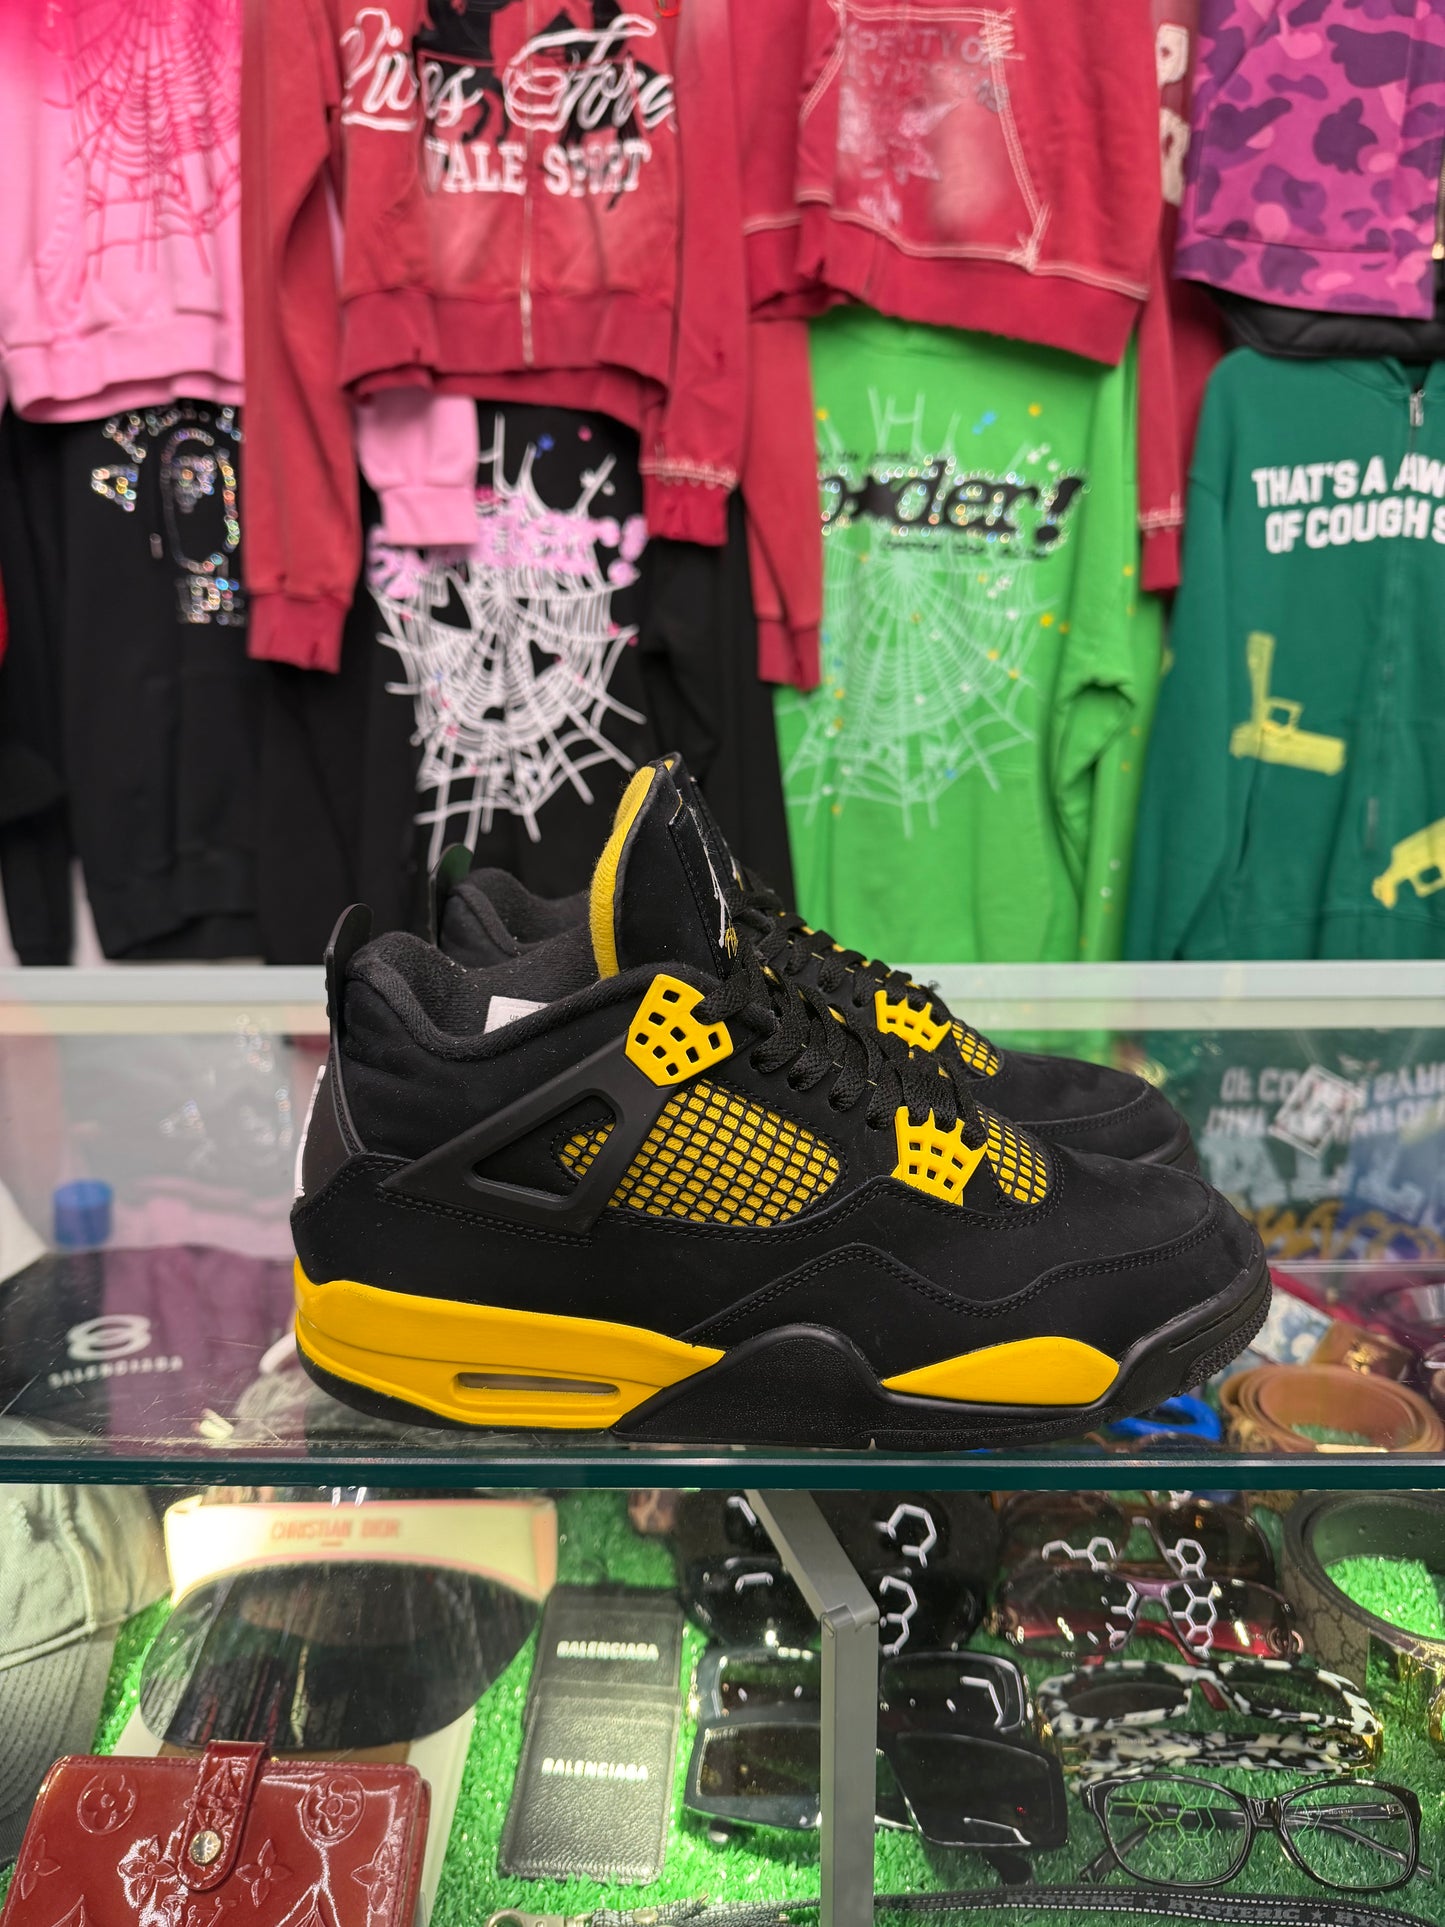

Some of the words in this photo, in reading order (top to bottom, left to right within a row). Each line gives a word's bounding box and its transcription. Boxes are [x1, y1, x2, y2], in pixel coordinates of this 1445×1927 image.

[1251, 459, 1360, 508] THAT'S
[1360, 455, 1388, 496] A
[1265, 510, 1304, 554] OF
[1305, 496, 1431, 549] COUGH
[556, 1640, 660, 1662] BALENCIAGA
[541, 1756, 649, 1782] BALENCIAGA
[1167, 1898, 1301, 1922] HYSTERIC
